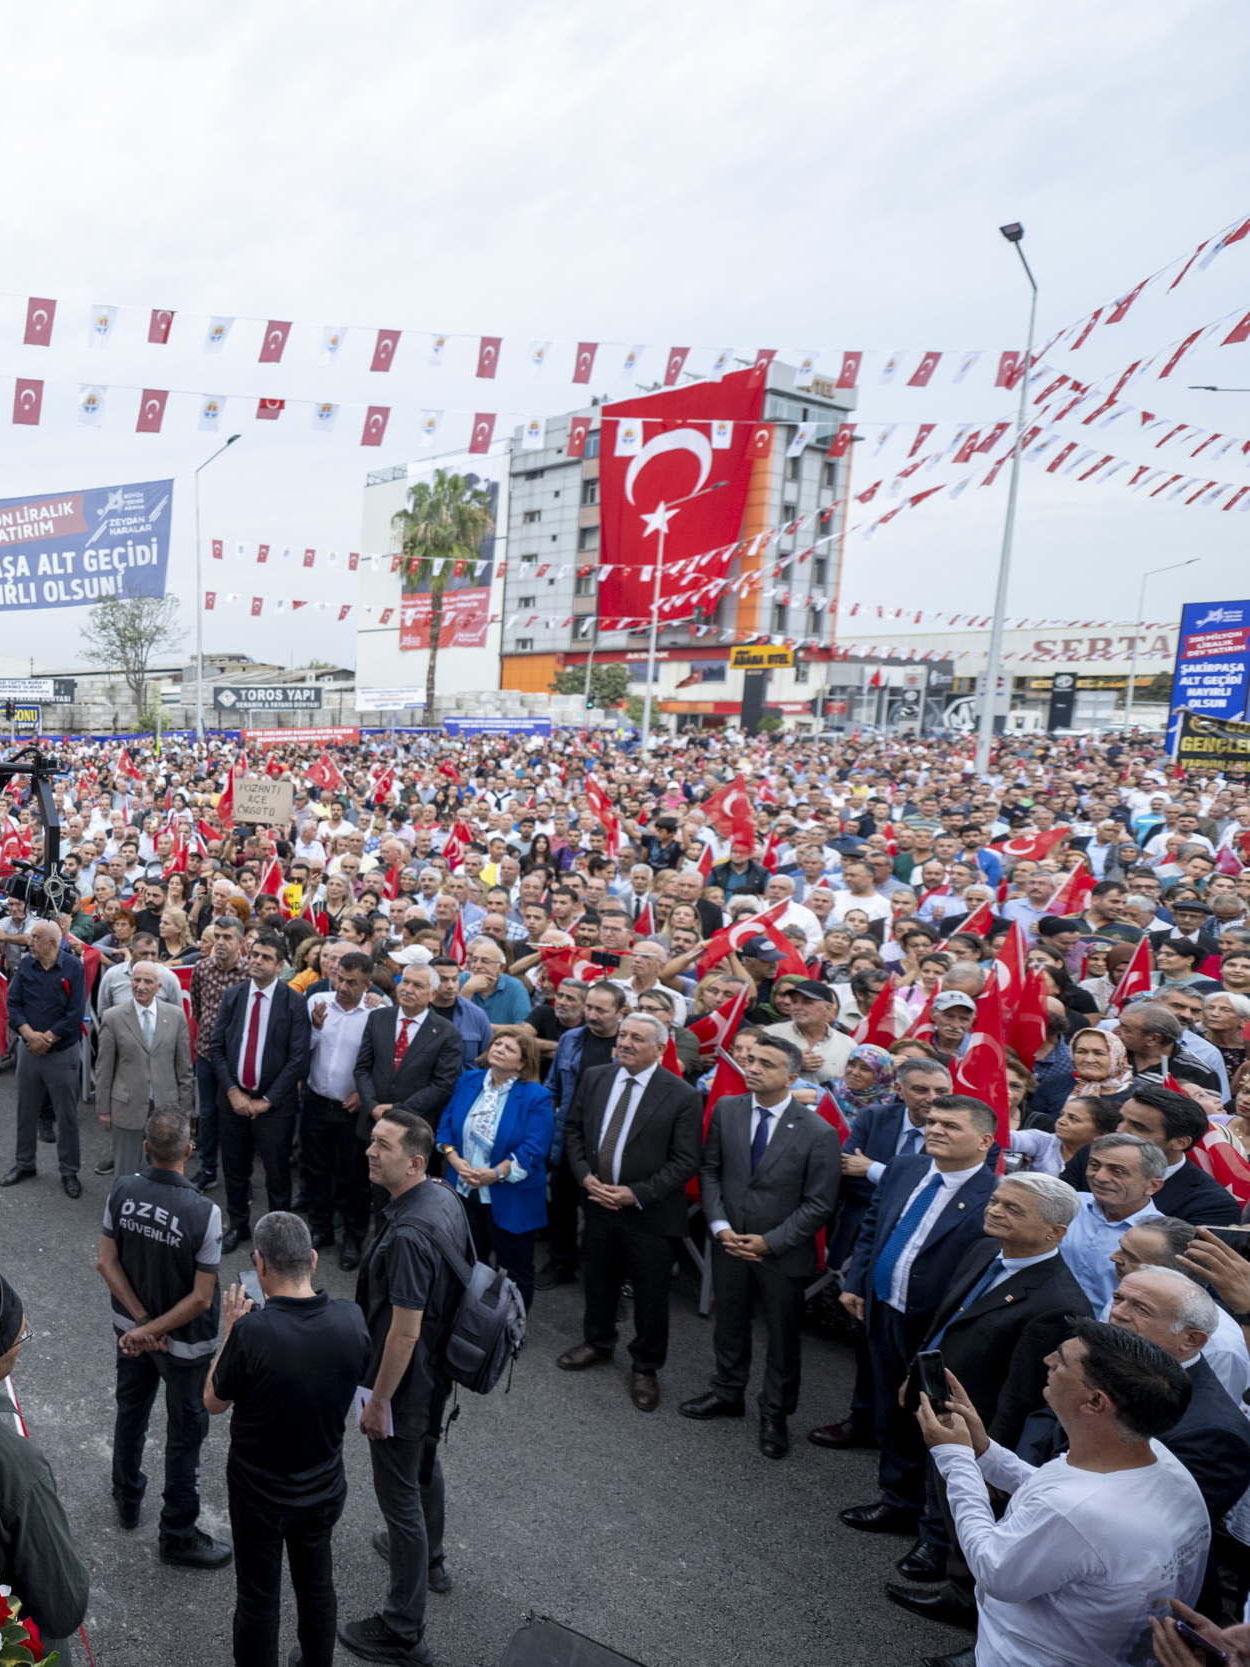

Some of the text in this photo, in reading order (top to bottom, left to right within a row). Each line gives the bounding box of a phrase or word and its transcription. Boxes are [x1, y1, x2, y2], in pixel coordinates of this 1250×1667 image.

[15, 502, 74, 524] LİRALIK
[109, 516, 145, 527] ZEYDAN
[109, 524, 152, 535] KARALAR
[37, 552, 76, 576] ALT
[83, 537, 158, 576] GEÇİDİ
[43, 575, 124, 603] OLSUN!
[1205, 630, 1243, 642] MİLYON
[1196, 639, 1234, 650] LİRALIK
[1186, 644, 1246, 658] DEV YATIRIM
[767, 653, 790, 665] OTEL
[1179, 661, 1245, 676] ŞAKİRPAŞA
[1179, 673, 1243, 687] ALT GEÇİDİ
[239, 689, 315, 701] TOROS YAPI
[1186, 687, 1232, 697] HAYIRLI
[235, 700, 264, 709] SERAMİK
[293, 700, 320, 708] DÜNYASI
[1187, 699, 1227, 708] OLSUN
[1181, 736, 1250, 755] GENÇLE
[239, 783, 281, 795] POZANTI
[121, 1198, 184, 1238] ÖZEL
[119, 1217, 182, 1248] GÜVENLİK
